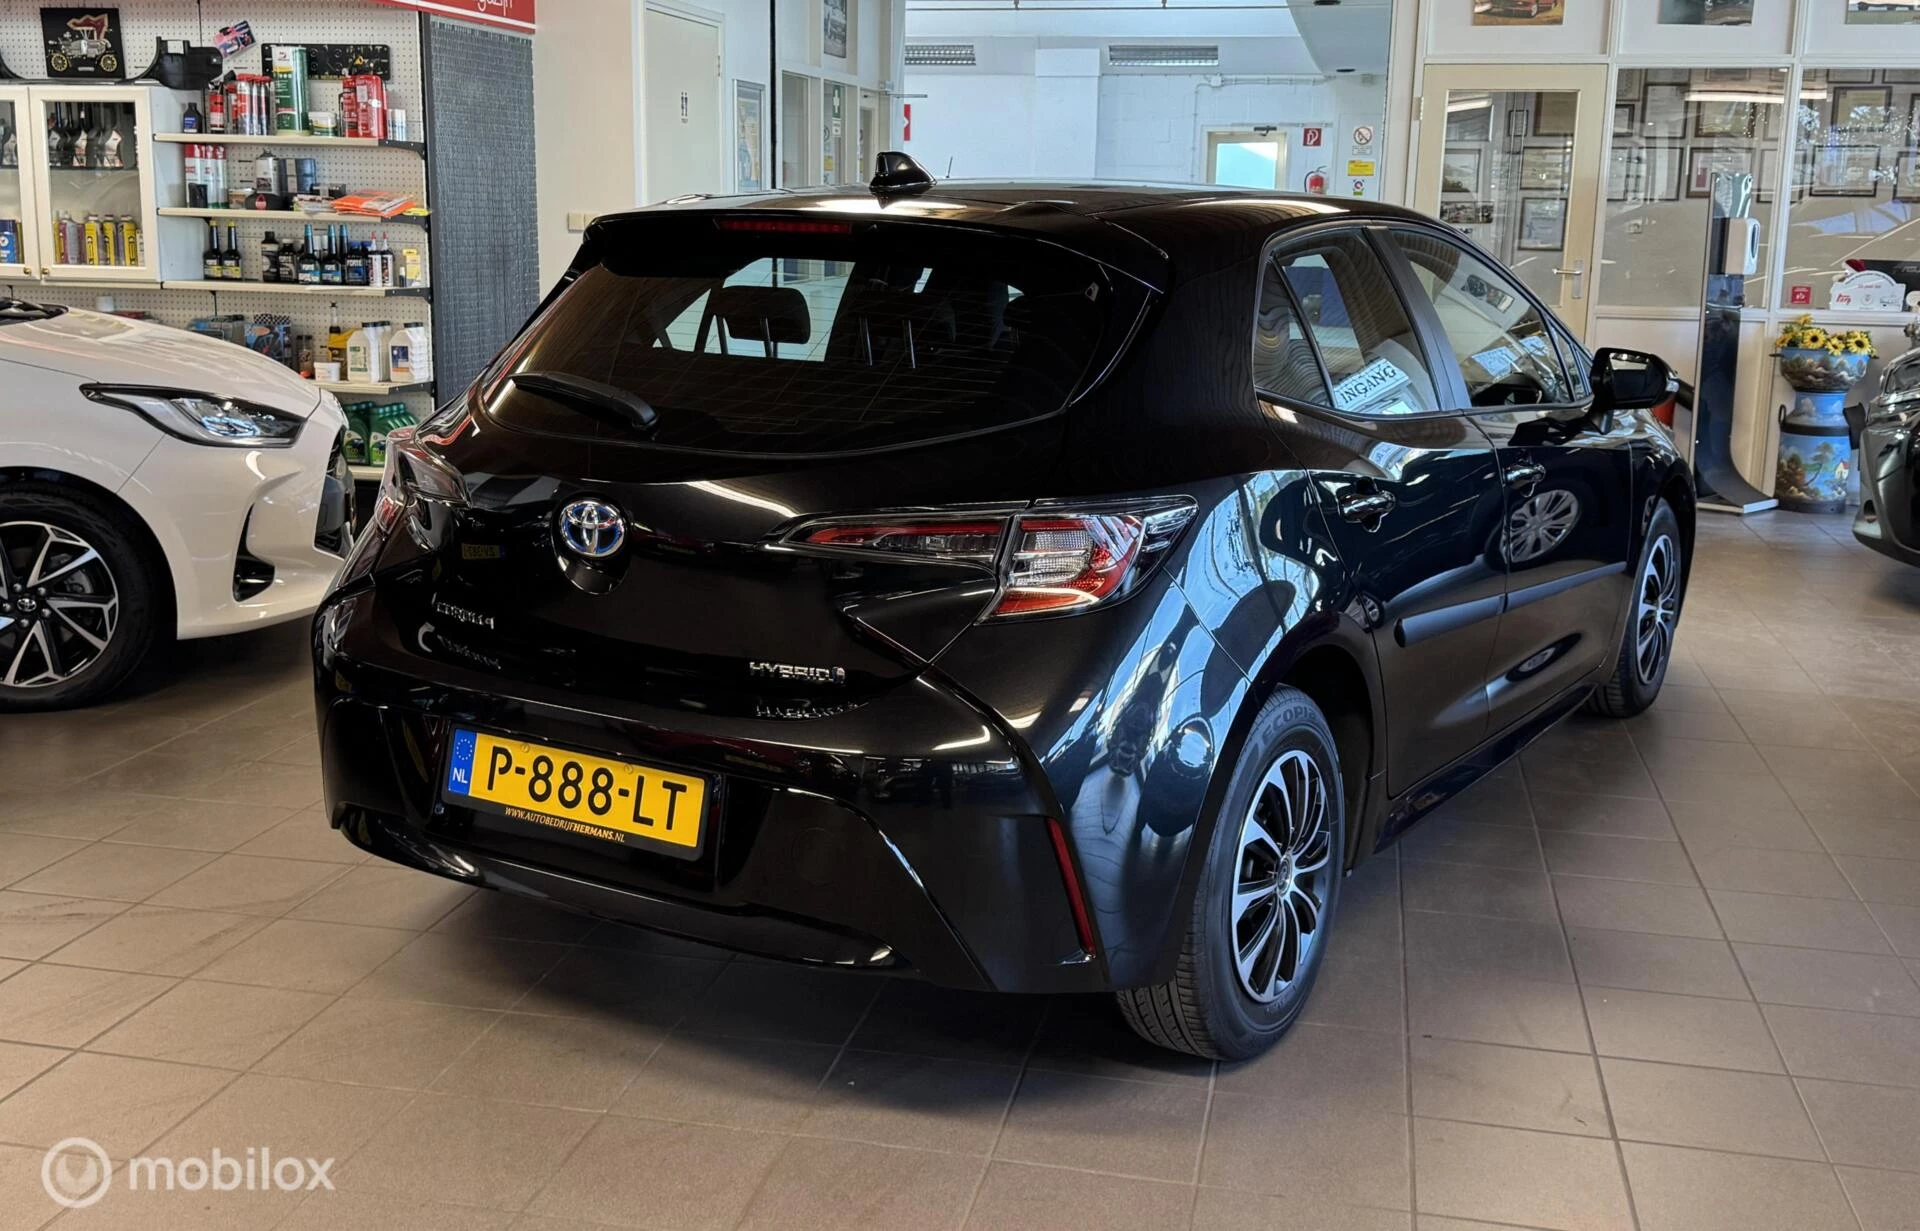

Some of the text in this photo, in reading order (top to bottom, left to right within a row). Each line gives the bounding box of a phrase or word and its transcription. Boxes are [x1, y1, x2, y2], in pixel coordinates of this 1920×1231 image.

[1340, 364, 1397, 404] INGANG
[749, 661, 833, 681] HYBRID
[452, 768, 468, 784] NL
[487, 745, 688, 831] P-888-LT
[504, 807, 626, 843] WWW.AUTOBEDRIJFHERMANS.NL
